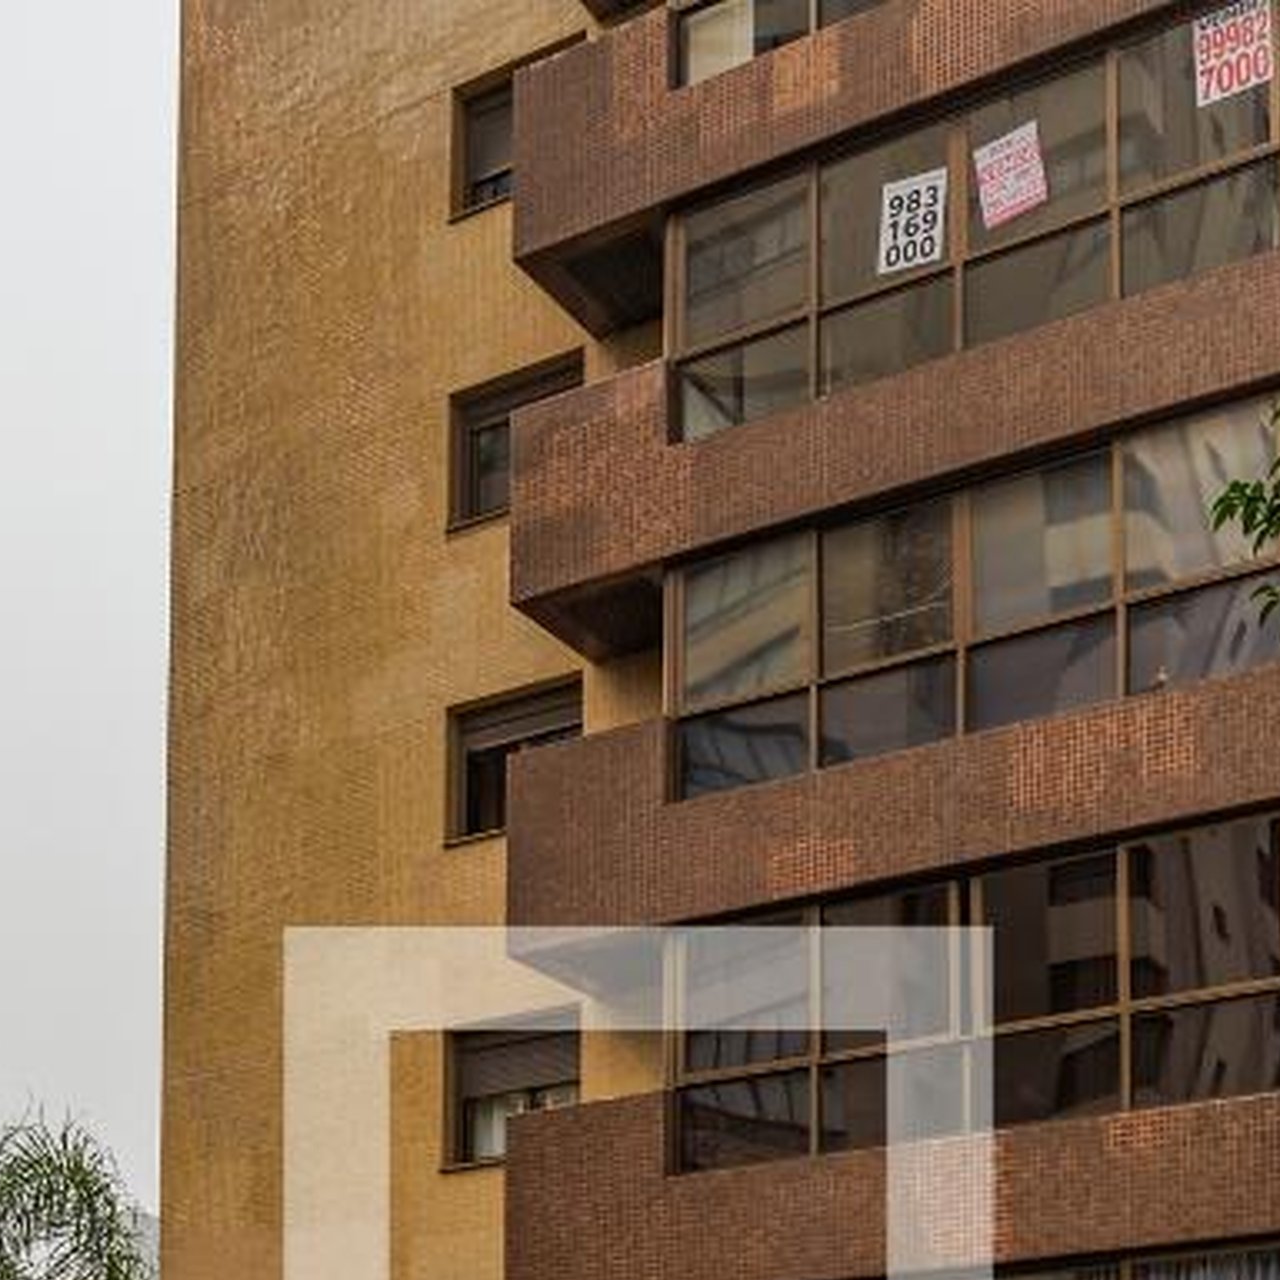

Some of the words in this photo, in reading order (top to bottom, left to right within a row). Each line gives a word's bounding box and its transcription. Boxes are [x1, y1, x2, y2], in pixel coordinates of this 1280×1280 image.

[1199, 44, 1270, 100] 7000
[888, 184, 939, 219] 983
[888, 210, 938, 241] 169
[885, 235, 936, 267] 000
